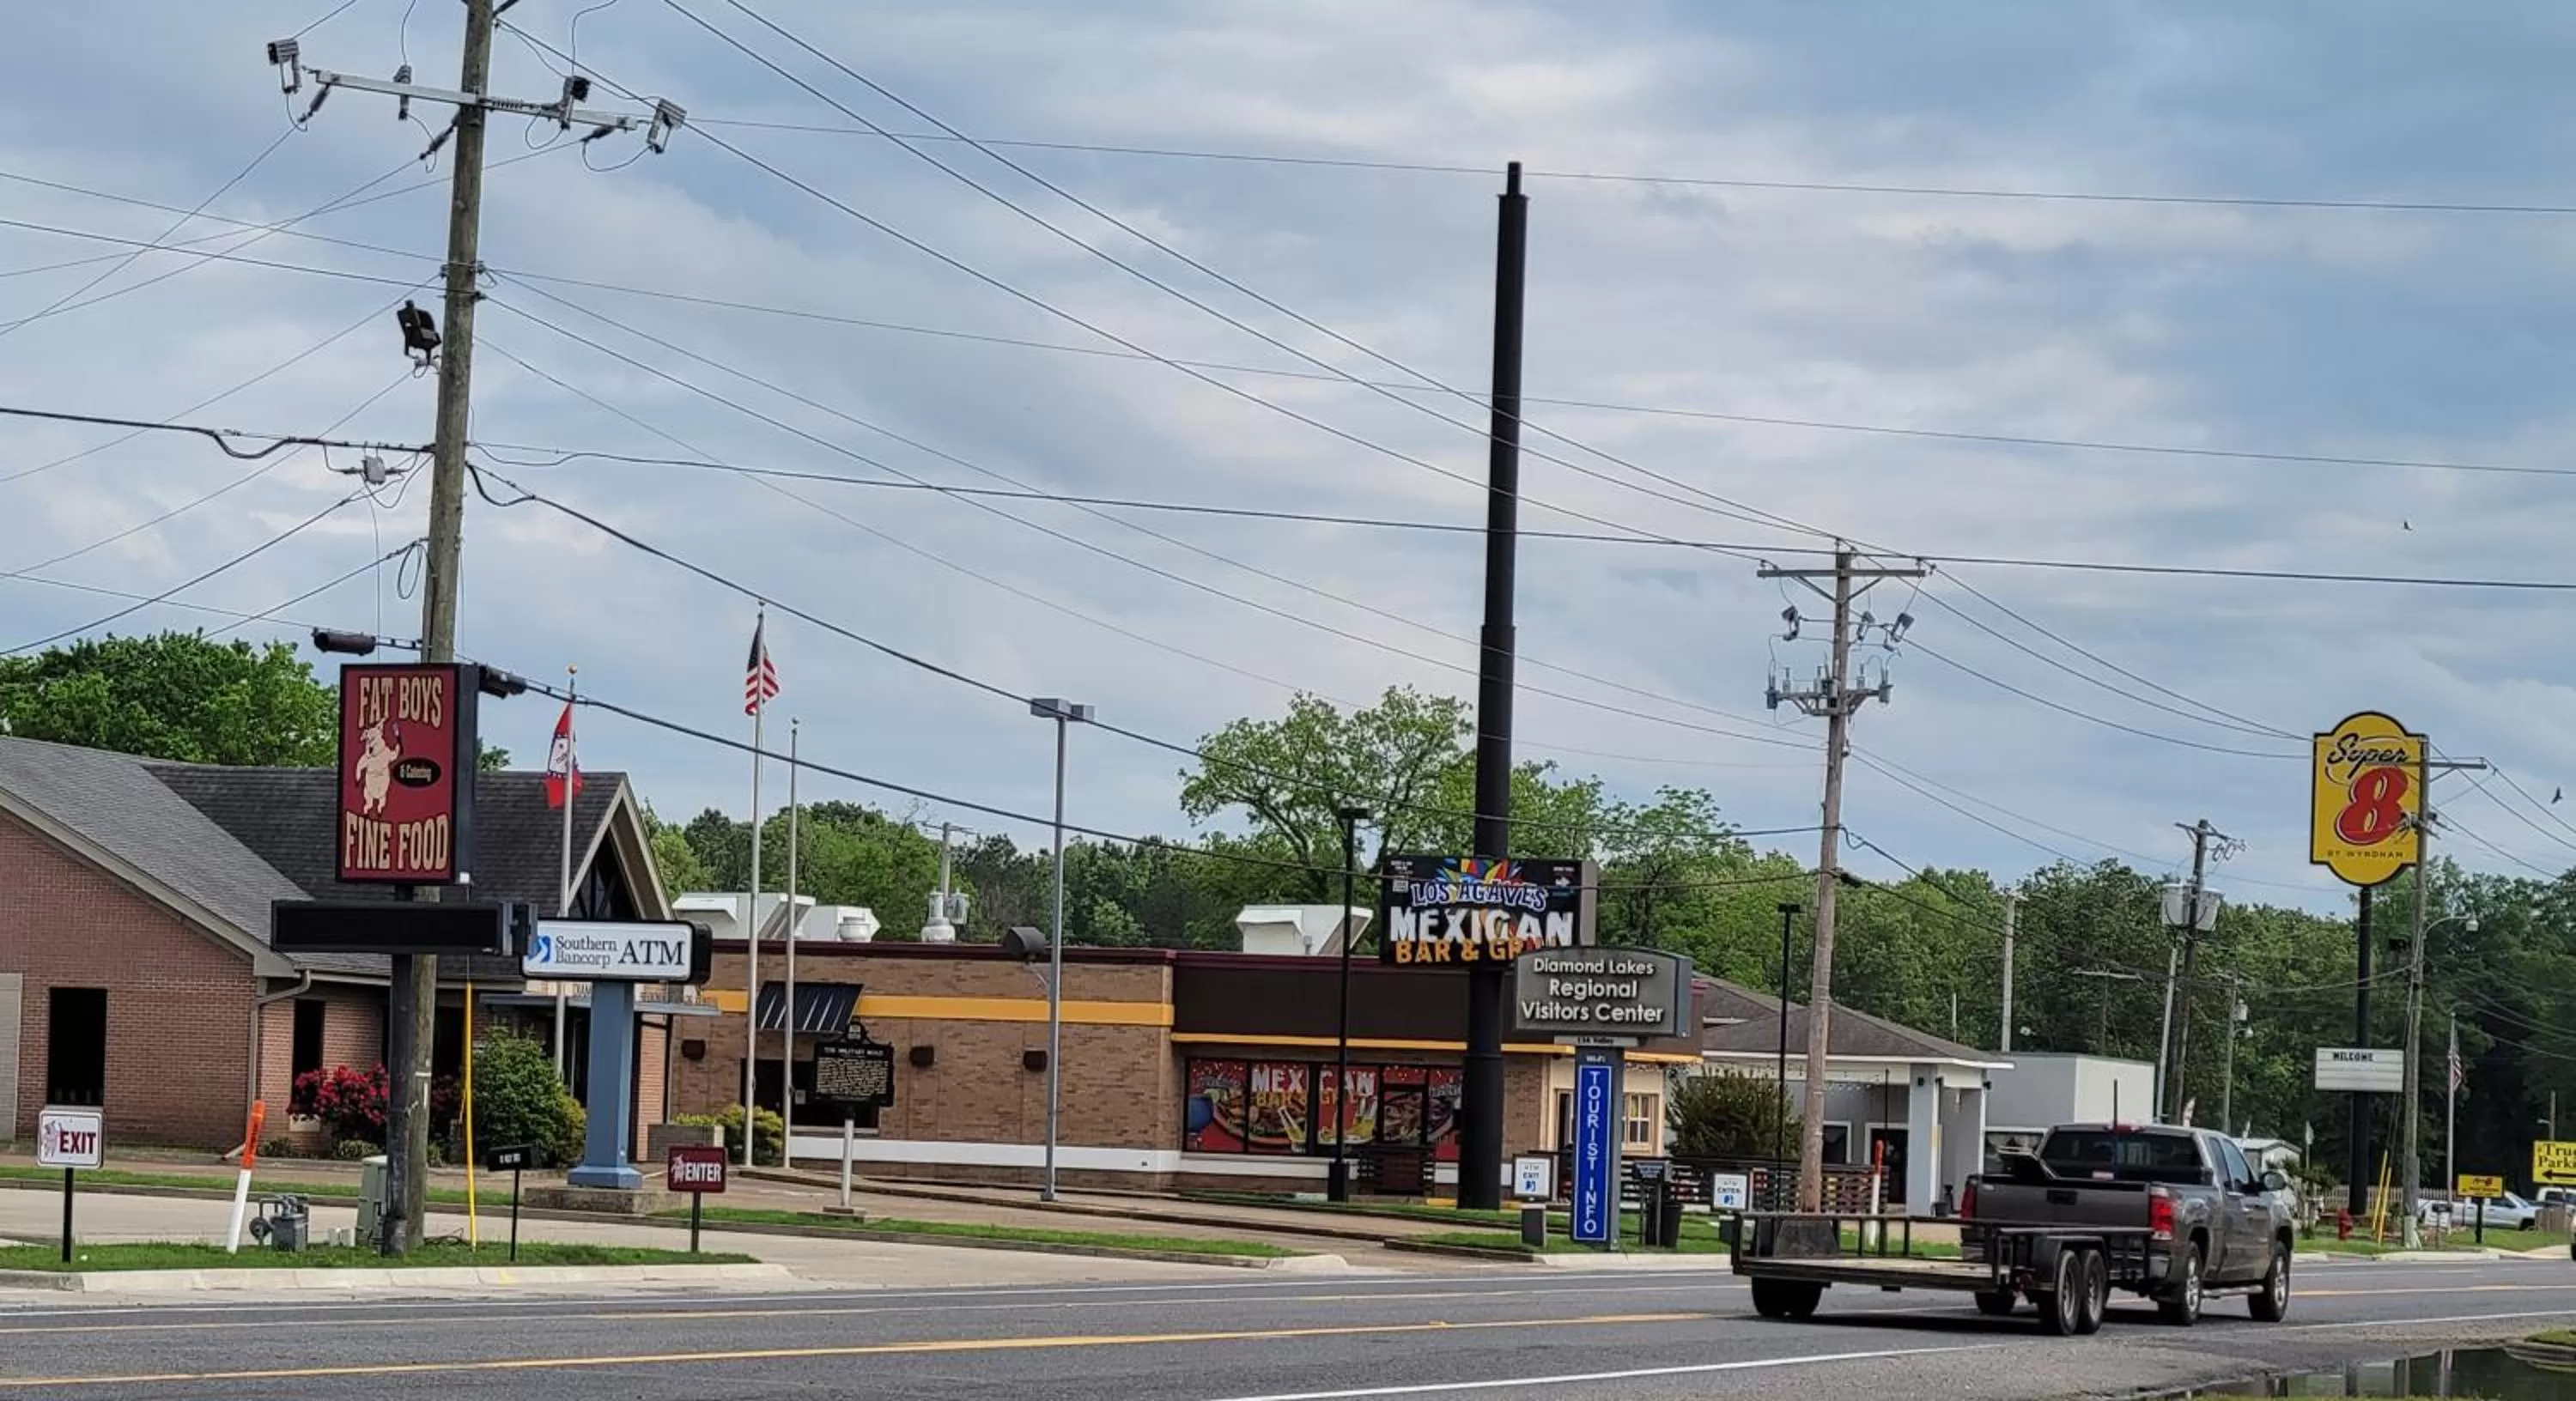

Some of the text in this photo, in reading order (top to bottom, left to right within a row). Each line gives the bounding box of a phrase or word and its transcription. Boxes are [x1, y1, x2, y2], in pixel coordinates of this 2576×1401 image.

[358, 676, 442, 728] FAT BOYS
[2326, 732, 2409, 779] Super
[2334, 765, 2408, 846] 8
[344, 811, 449, 870] FINE FOOD
[2327, 849, 2404, 858] BY WYNDHAM
[1411, 878, 1549, 912] LOS AGAVES
[1389, 906, 1575, 947] MEXICAN
[555, 935, 618, 952] Southern
[618, 939, 685, 966] ATM
[1395, 938, 1451, 964] BAR
[1460, 938, 1480, 961] &
[555, 950, 611, 968] Bancorp
[1534, 957, 1656, 975] Diamond Lakes
[1549, 978, 1637, 1000] Regional
[1522, 1001, 1664, 1022] Visitors Center
[2333, 1052, 2373, 1062] WELCOME
[1587, 1070, 1601, 1171] TOURIST
[60, 1131, 96, 1154] EXIT
[685, 1162, 722, 1182] ENTER
[1584, 1177, 1598, 1234] INFO
